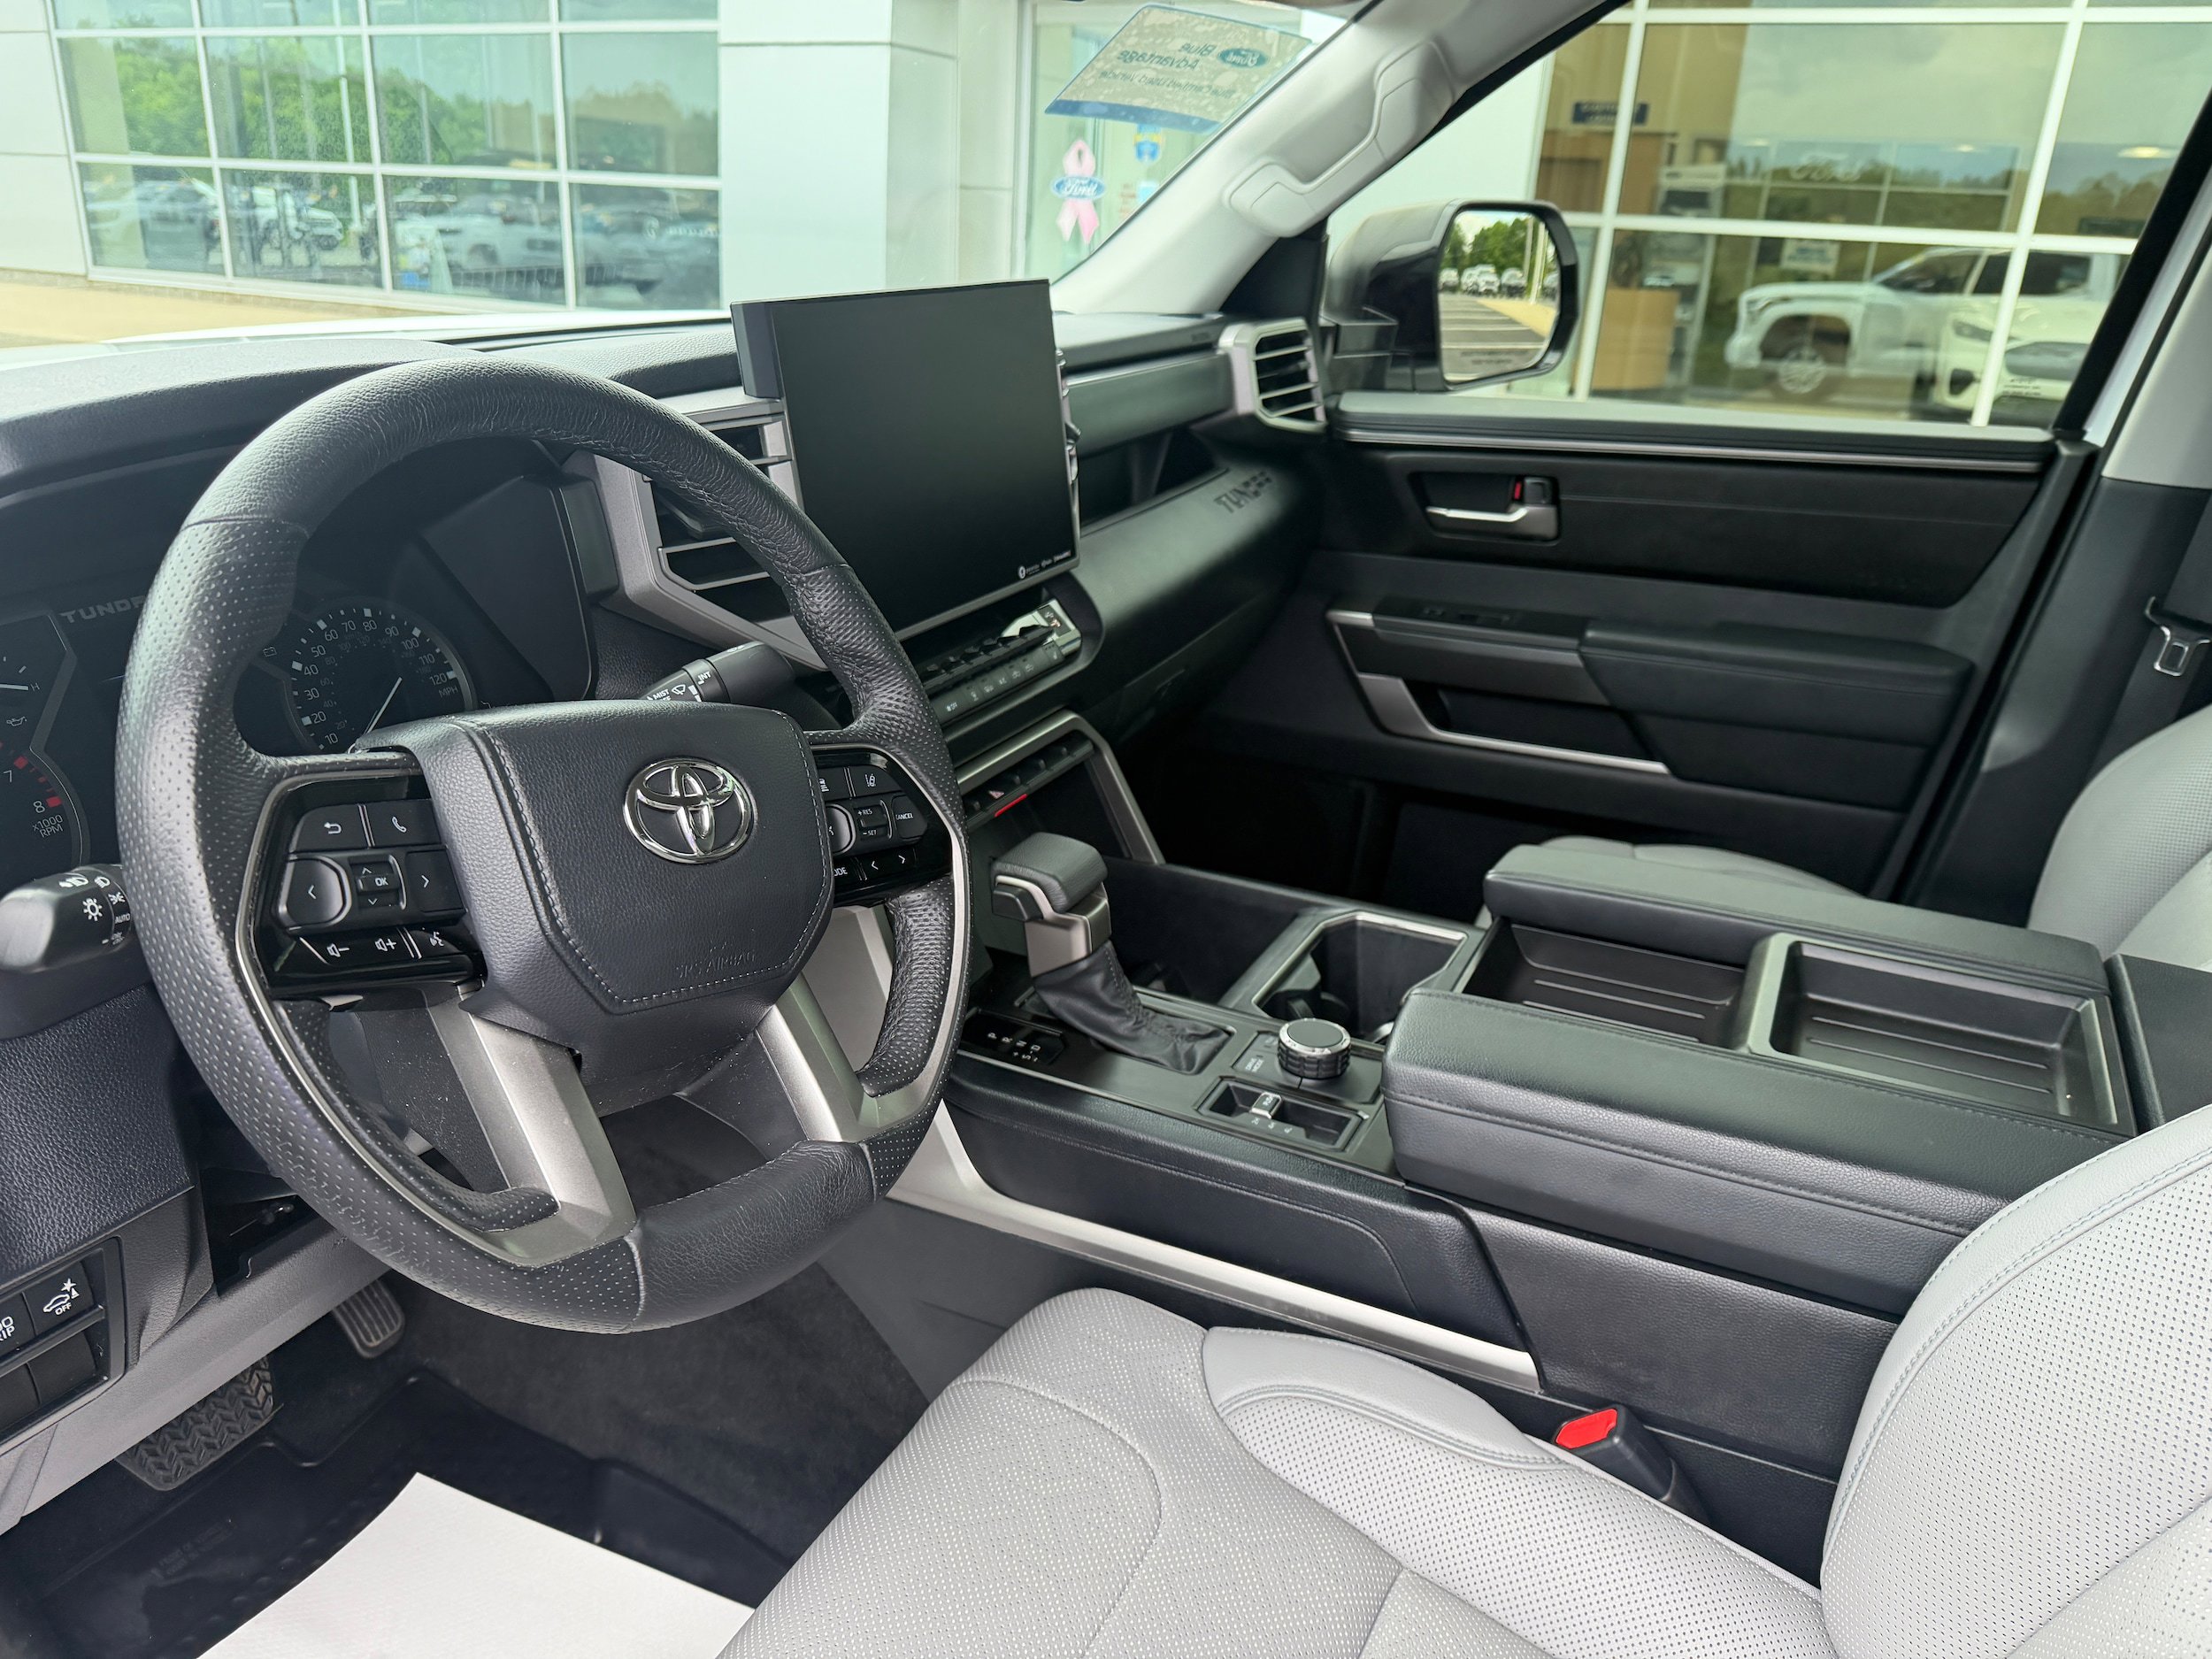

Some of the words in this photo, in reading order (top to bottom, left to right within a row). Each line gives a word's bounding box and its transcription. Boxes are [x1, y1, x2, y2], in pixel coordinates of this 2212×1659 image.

[1062, 177, 1098, 197] Ford
[58, 594, 148, 624] TUNDR
[342, 620, 357, 633] 70
[363, 620, 378, 632] 80
[385, 626, 400, 637] 90
[324, 629, 339, 641] 60
[401, 637, 419, 650] 100
[311, 644, 326, 658] 50
[419, 653, 435, 666] 110
[303, 664, 319, 676] 40
[698, 672, 711, 681] INT
[429, 673, 448, 687] 120
[304, 687, 319, 701] 30
[438, 685, 459, 698] MPH
[653, 689, 670, 700] MIST
[311, 710, 326, 724] 20
[324, 733, 339, 745] 10
[4, 770, 13, 782] 7
[33, 800, 45, 813] 8
[32, 814, 64, 831] x1000
[39, 823, 64, 838] RPM
[375, 877, 388, 887] OK
[115, 913, 130, 924] AUTO
[55, 1302, 72, 1316] OFF
